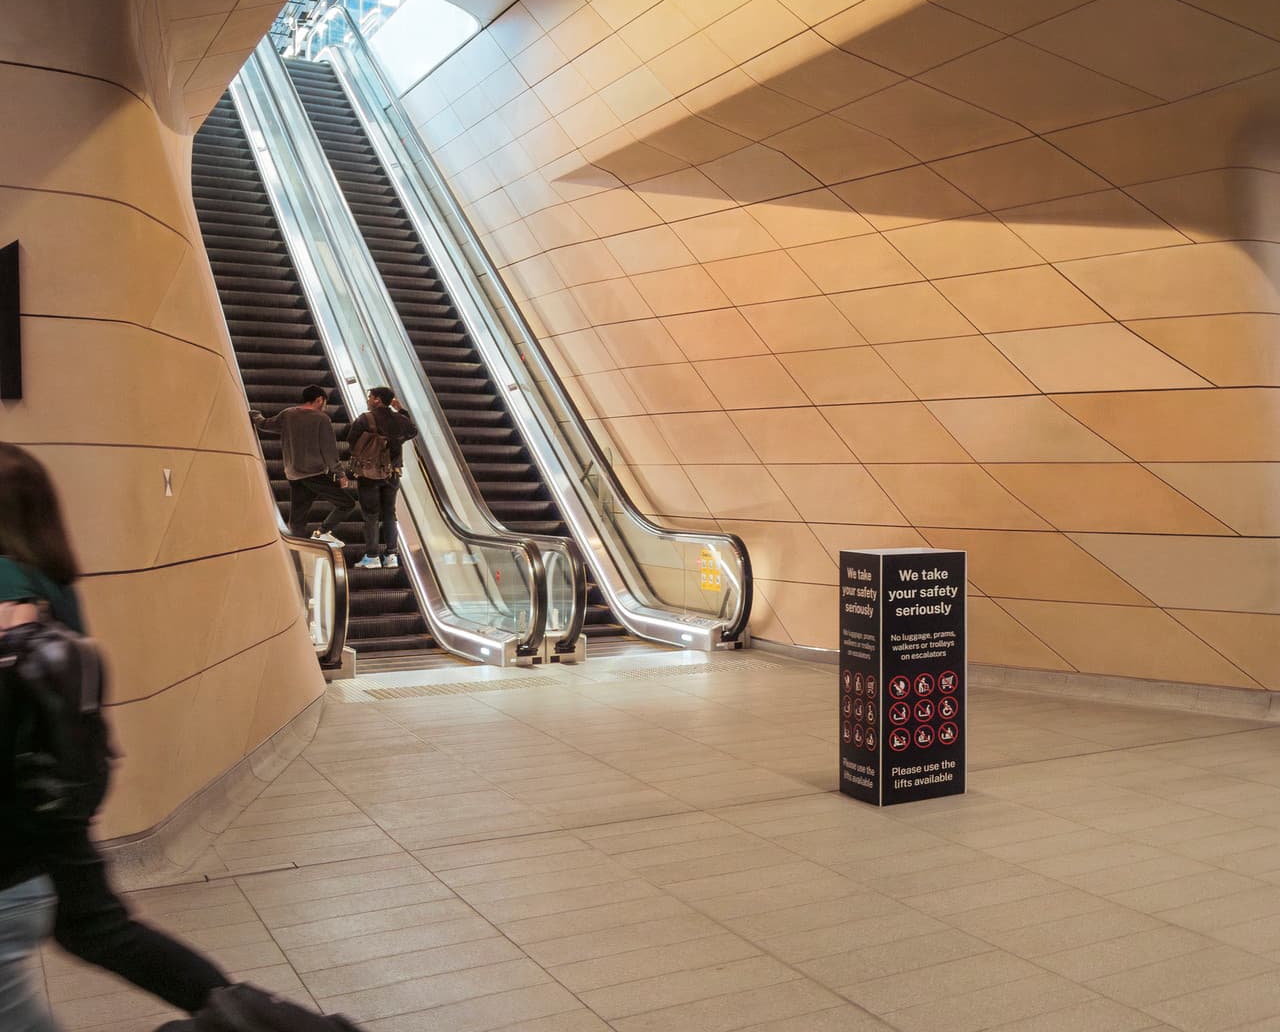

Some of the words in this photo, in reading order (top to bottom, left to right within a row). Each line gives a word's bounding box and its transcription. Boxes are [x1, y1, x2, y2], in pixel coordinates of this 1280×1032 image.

[847, 568, 856, 580] We
[858, 569, 872, 581] take
[899, 569, 919, 581] We
[921, 568, 949, 581] take
[842, 586, 856, 597] your
[857, 586, 877, 601] safety
[888, 589, 918, 602] your
[919, 585, 958, 599] safety
[845, 602, 874, 618] seriously
[895, 602, 952, 617] seriously
[891, 634, 901, 642] No
[892, 642, 920, 652] walkers
[929, 639, 955, 649] trolleys
[911, 650, 947, 660] escalators
[892, 766, 922, 777] Please
[923, 763, 940, 772] use
[941, 759, 956, 769] the
[894, 779, 913, 789] lifts
[914, 772, 953, 786] available
